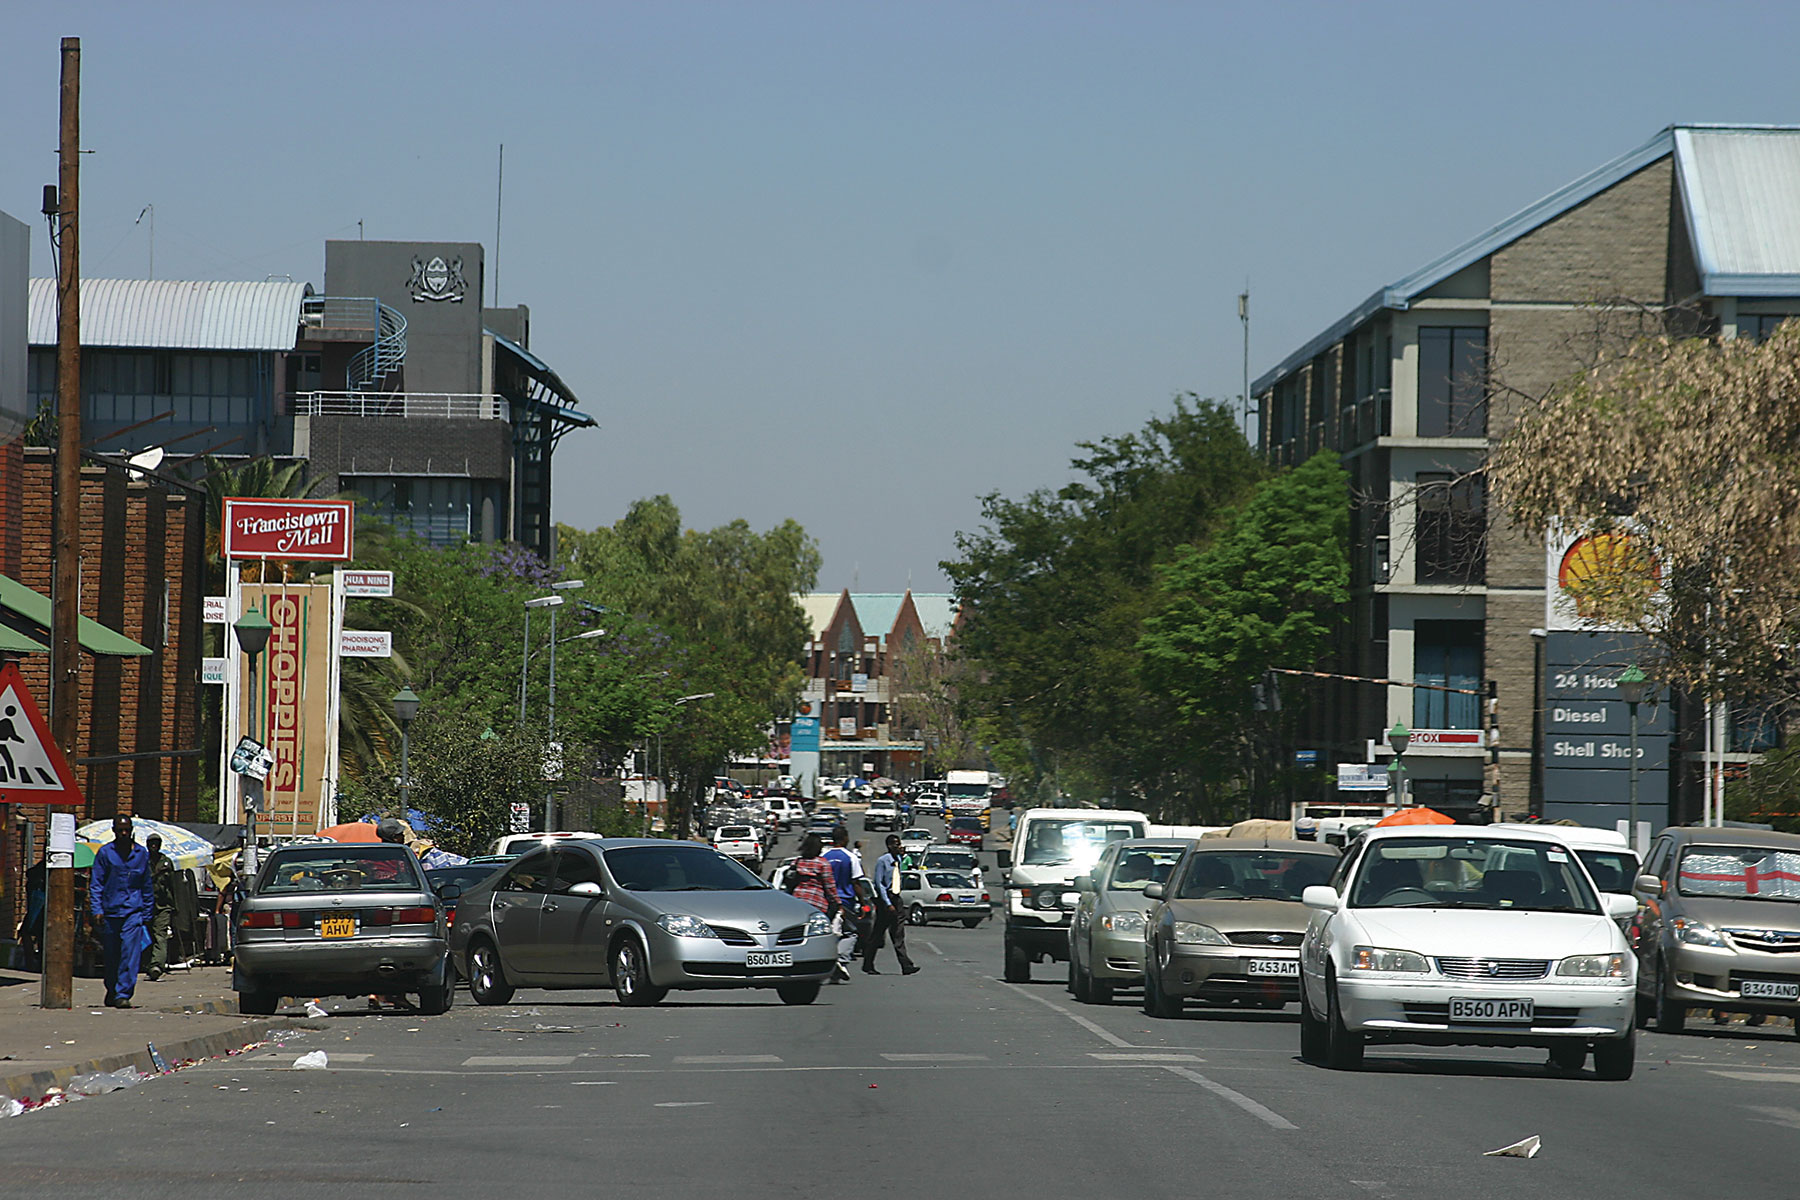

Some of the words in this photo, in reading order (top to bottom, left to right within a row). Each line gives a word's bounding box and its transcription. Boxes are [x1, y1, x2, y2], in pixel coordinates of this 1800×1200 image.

[236, 510, 339, 535] Francistown
[277, 524, 333, 552] Mall
[345, 575, 365, 584] HUA
[367, 576, 389, 585] NING
[1554, 674, 1579, 688] 24
[1583, 674, 1620, 689] Hou
[271, 599, 297, 787] CHOPPIES
[1553, 708, 1607, 723] Diesel
[1408, 733, 1438, 743] erox
[1553, 742, 1595, 757] Shell
[256, 814, 314, 823] UPRSTRE
[323, 914, 352, 925] B399
[326, 924, 349, 936] AHV
[747, 954, 770, 966] B560
[771, 953, 792, 965] ASE
[1744, 982, 1773, 995] B349
[1453, 1001, 1494, 1017] B560
[1497, 1002, 1532, 1018] APN
